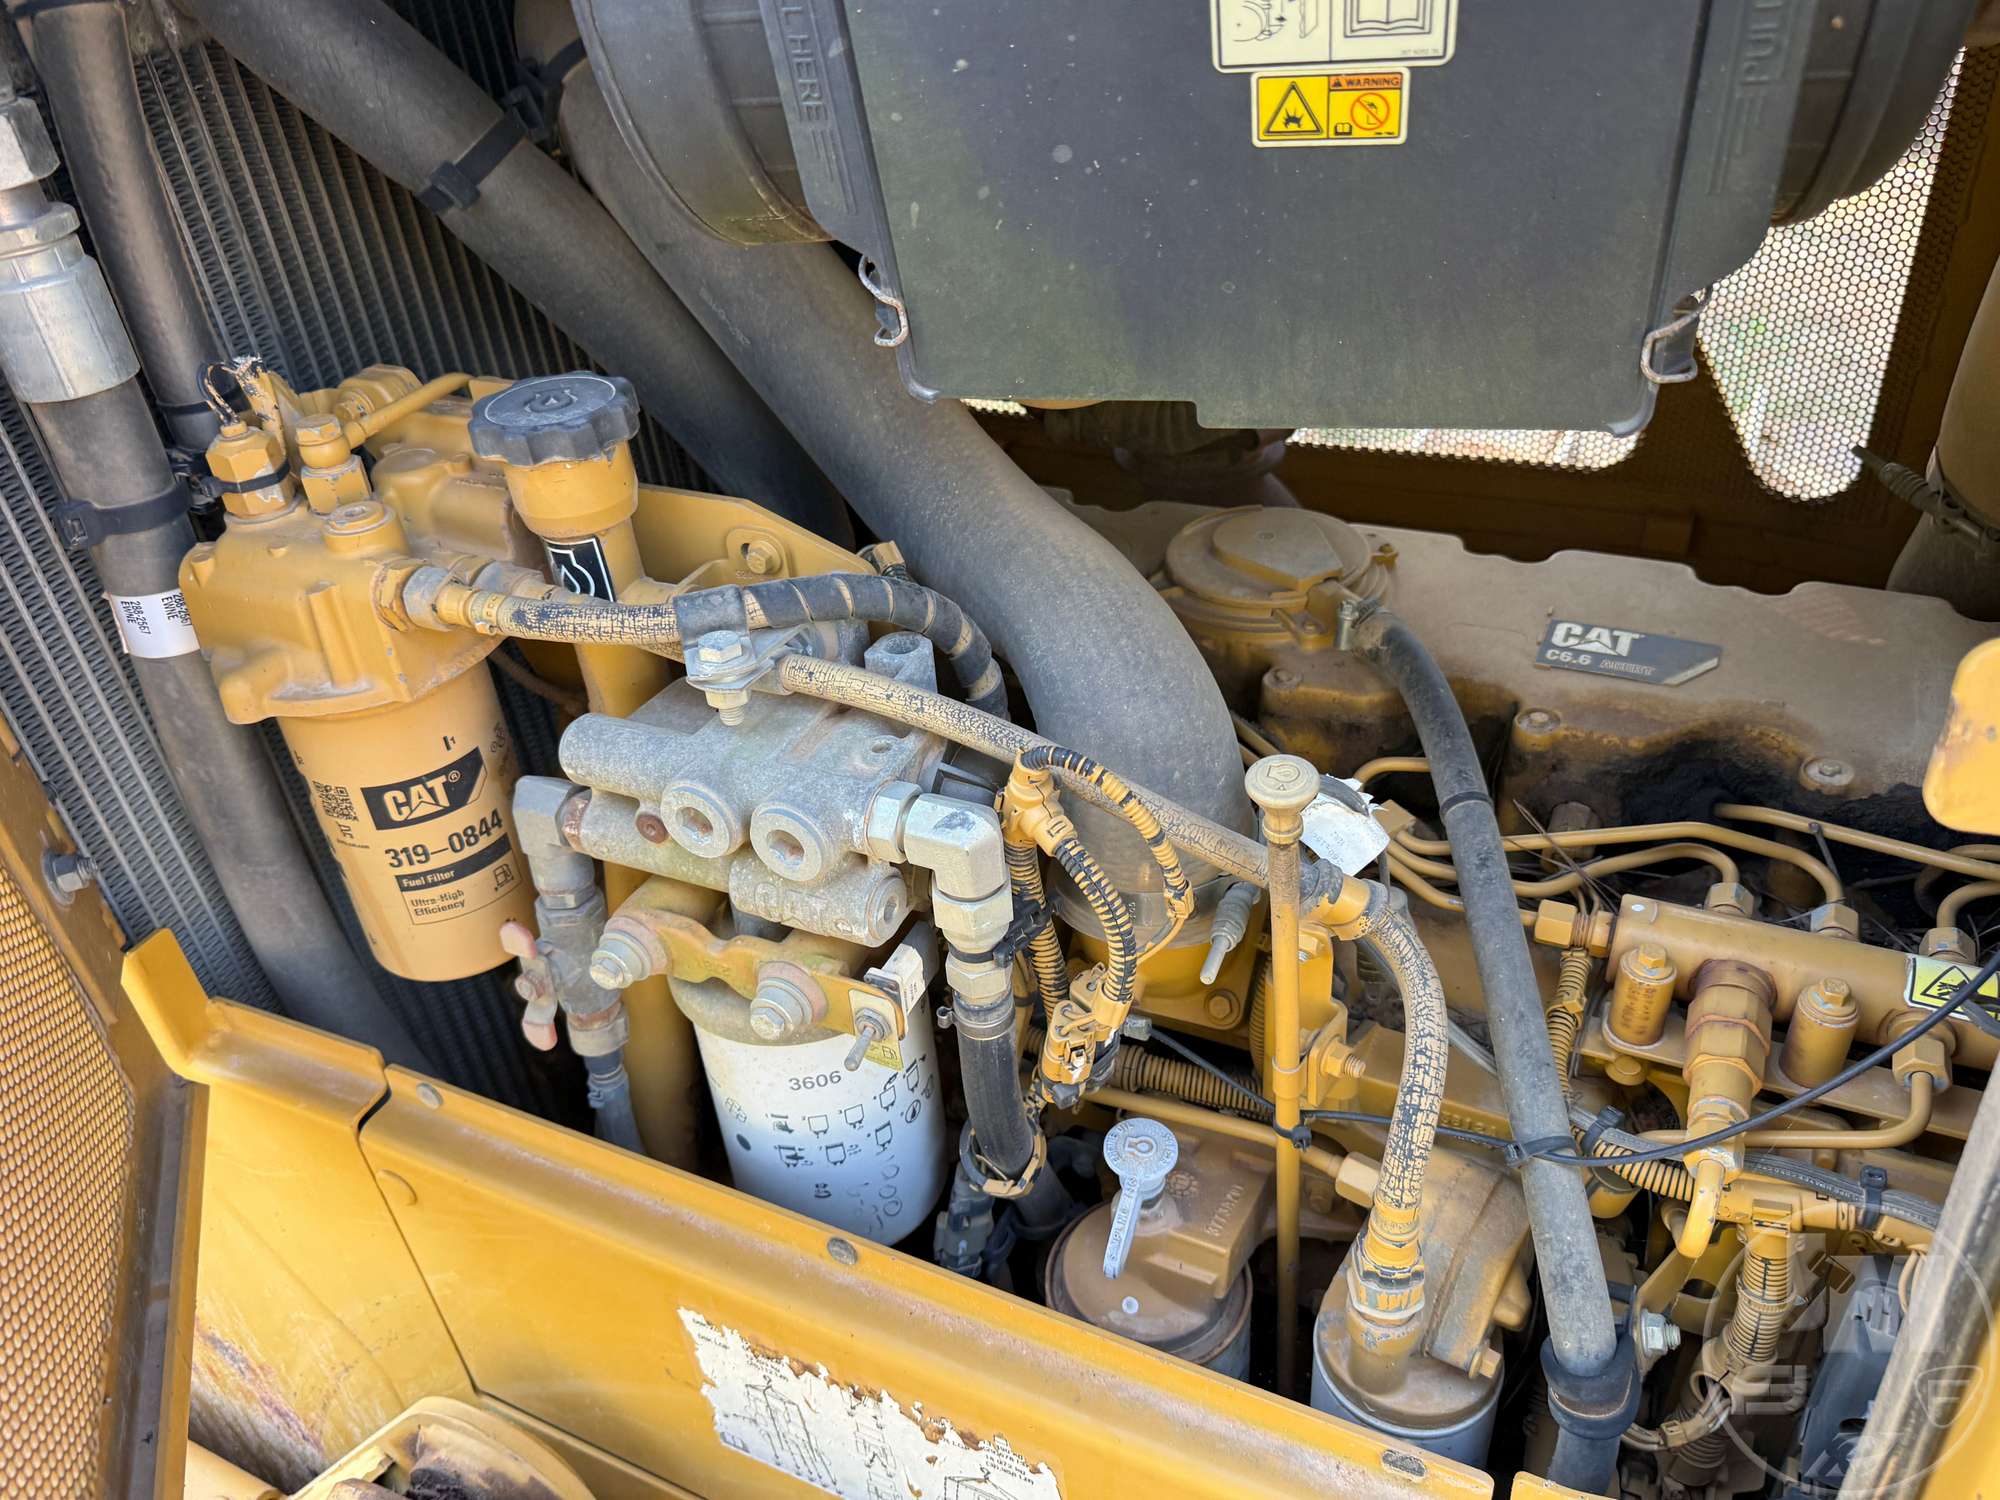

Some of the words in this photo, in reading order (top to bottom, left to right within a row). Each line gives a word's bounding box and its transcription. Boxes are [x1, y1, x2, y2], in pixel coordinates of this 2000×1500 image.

[786, 34, 827, 121] HERE
[1345, 76, 1400, 87] WARNING
[130, 600, 152, 635] 288-2567
[161, 595, 180, 621] EWNE
[1551, 621, 1639, 657] CAT
[1545, 649, 1592, 666] C6.6
[382, 773, 451, 822] CAT
[384, 808, 503, 869] 319-0844
[402, 875, 425, 889] Fuel
[427, 869, 456, 885] Filter
[410, 888, 465, 909] Ultra-High
[414, 898, 466, 917] Efficiency
[788, 1070, 842, 1092] 3606
